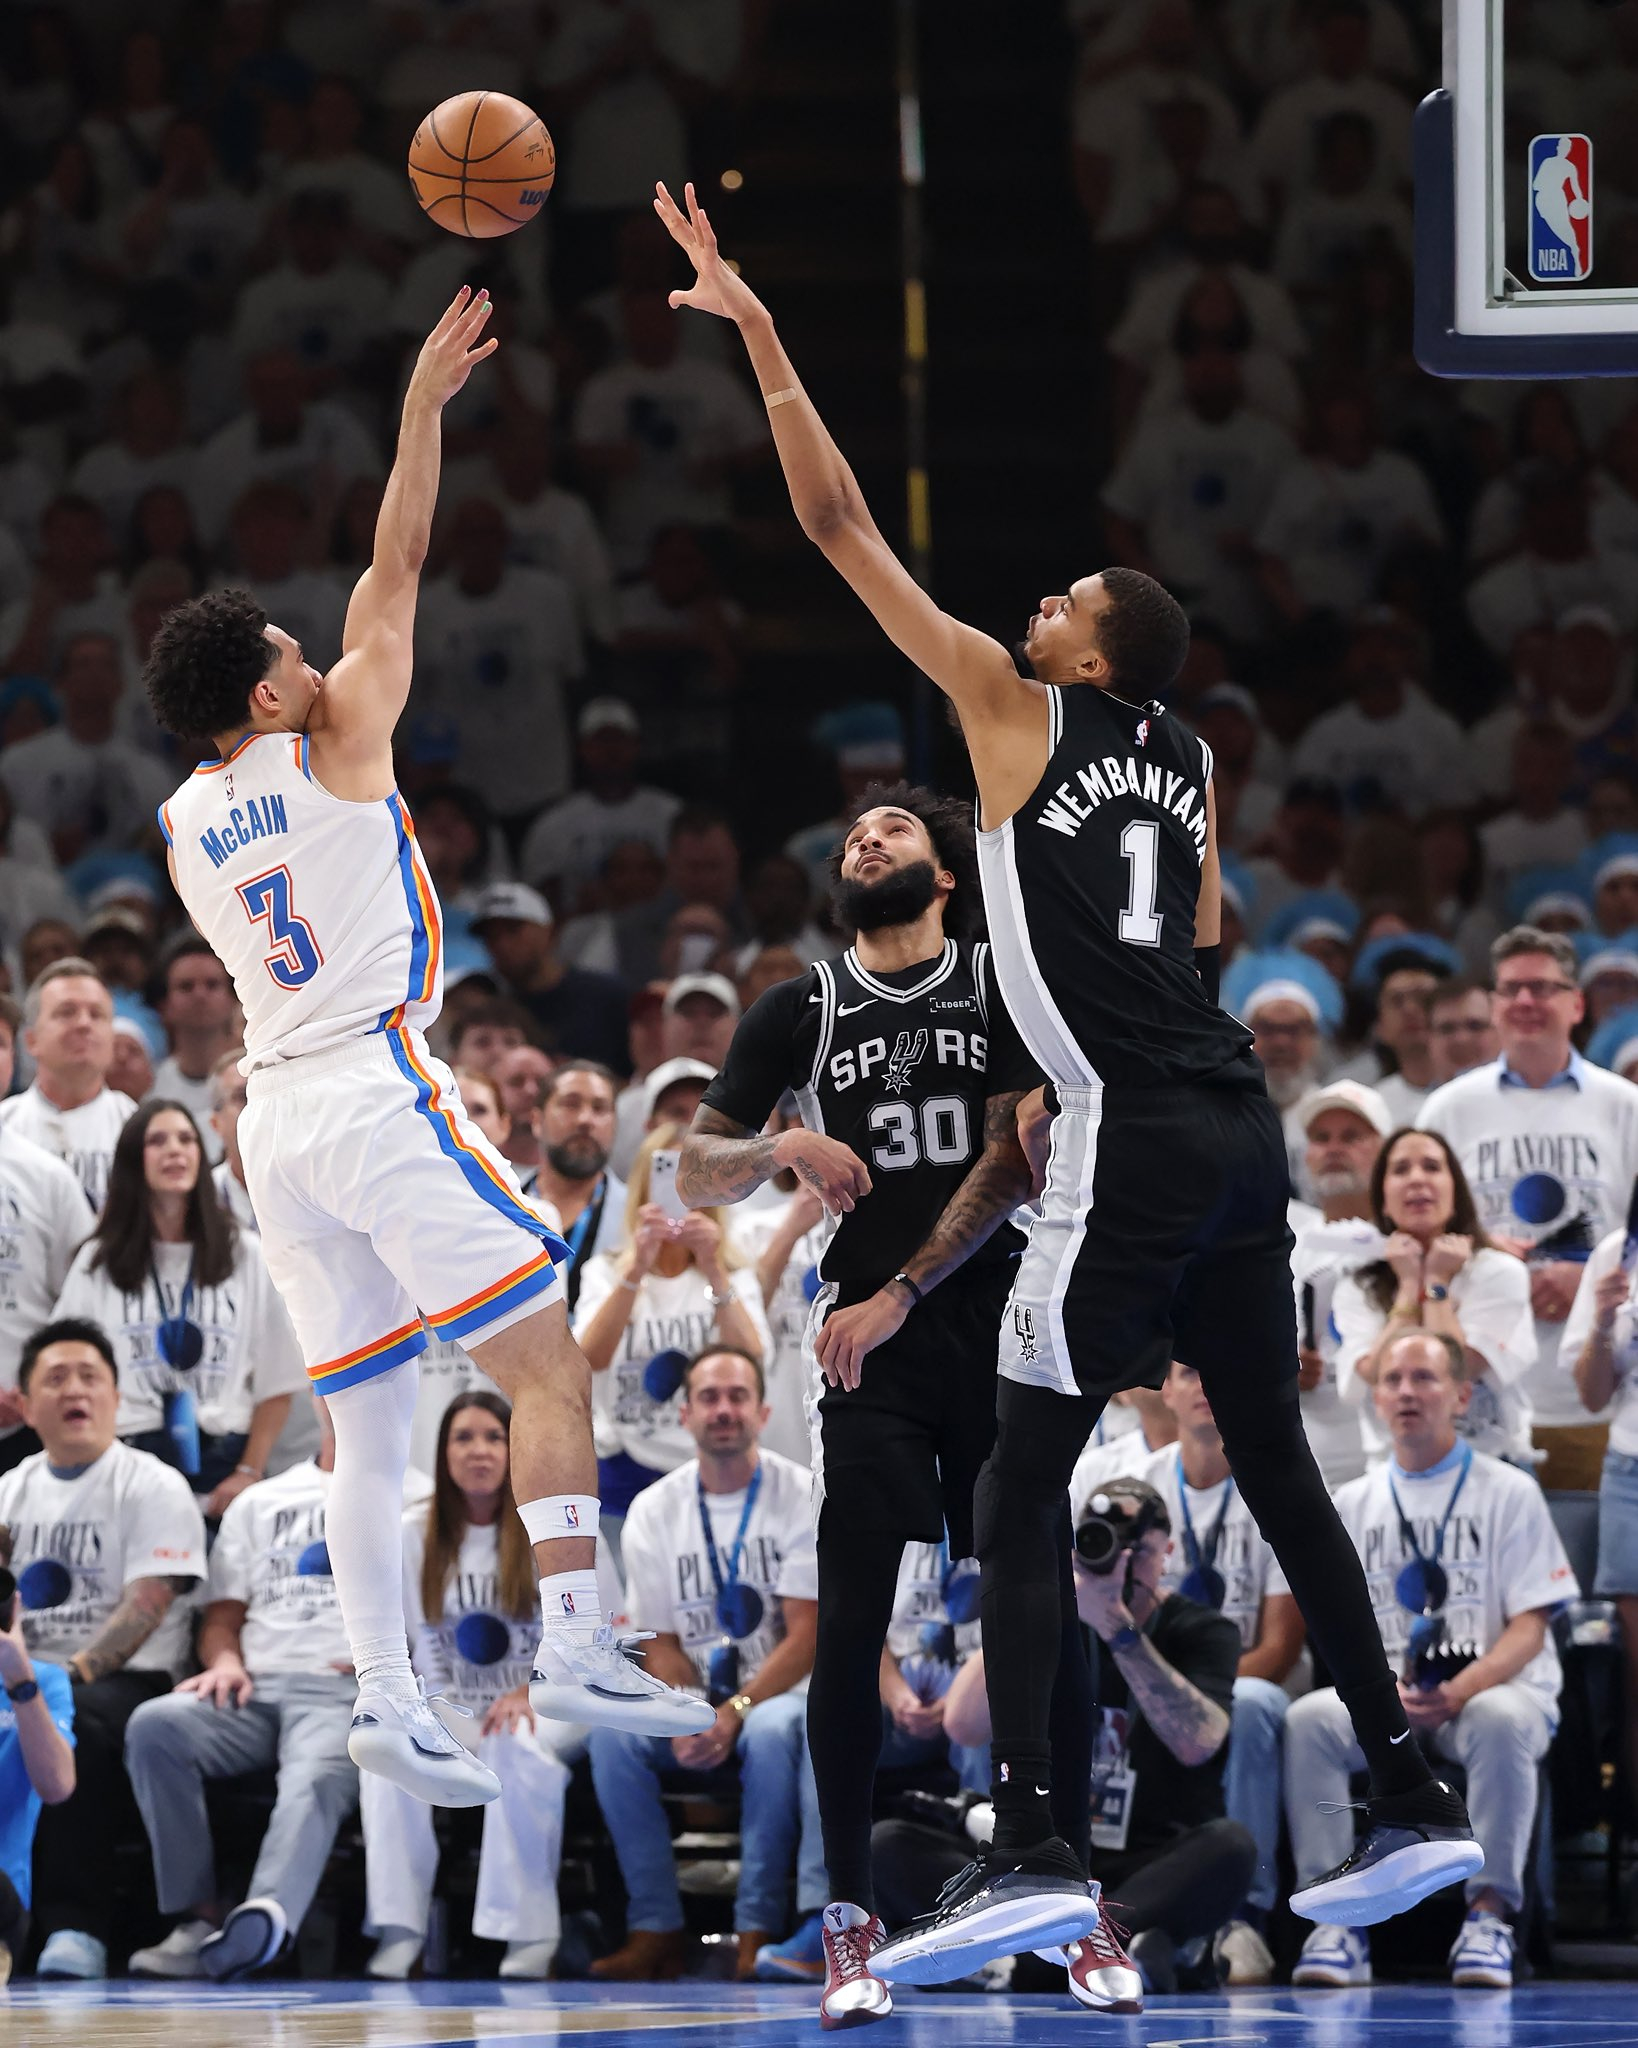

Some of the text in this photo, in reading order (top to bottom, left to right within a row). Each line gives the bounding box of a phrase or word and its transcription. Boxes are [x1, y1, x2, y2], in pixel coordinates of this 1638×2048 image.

[1538, 249, 1568, 272] NBA
[200, 794, 288, 869] McCAIN
[1118, 819, 1164, 948] 1
[234, 863, 325, 992] 3
[935, 1000, 971, 1009] LEDGER
[867, 1094, 972, 1172] 30
[1478, 1133, 1600, 1182] PLAYOFFS
